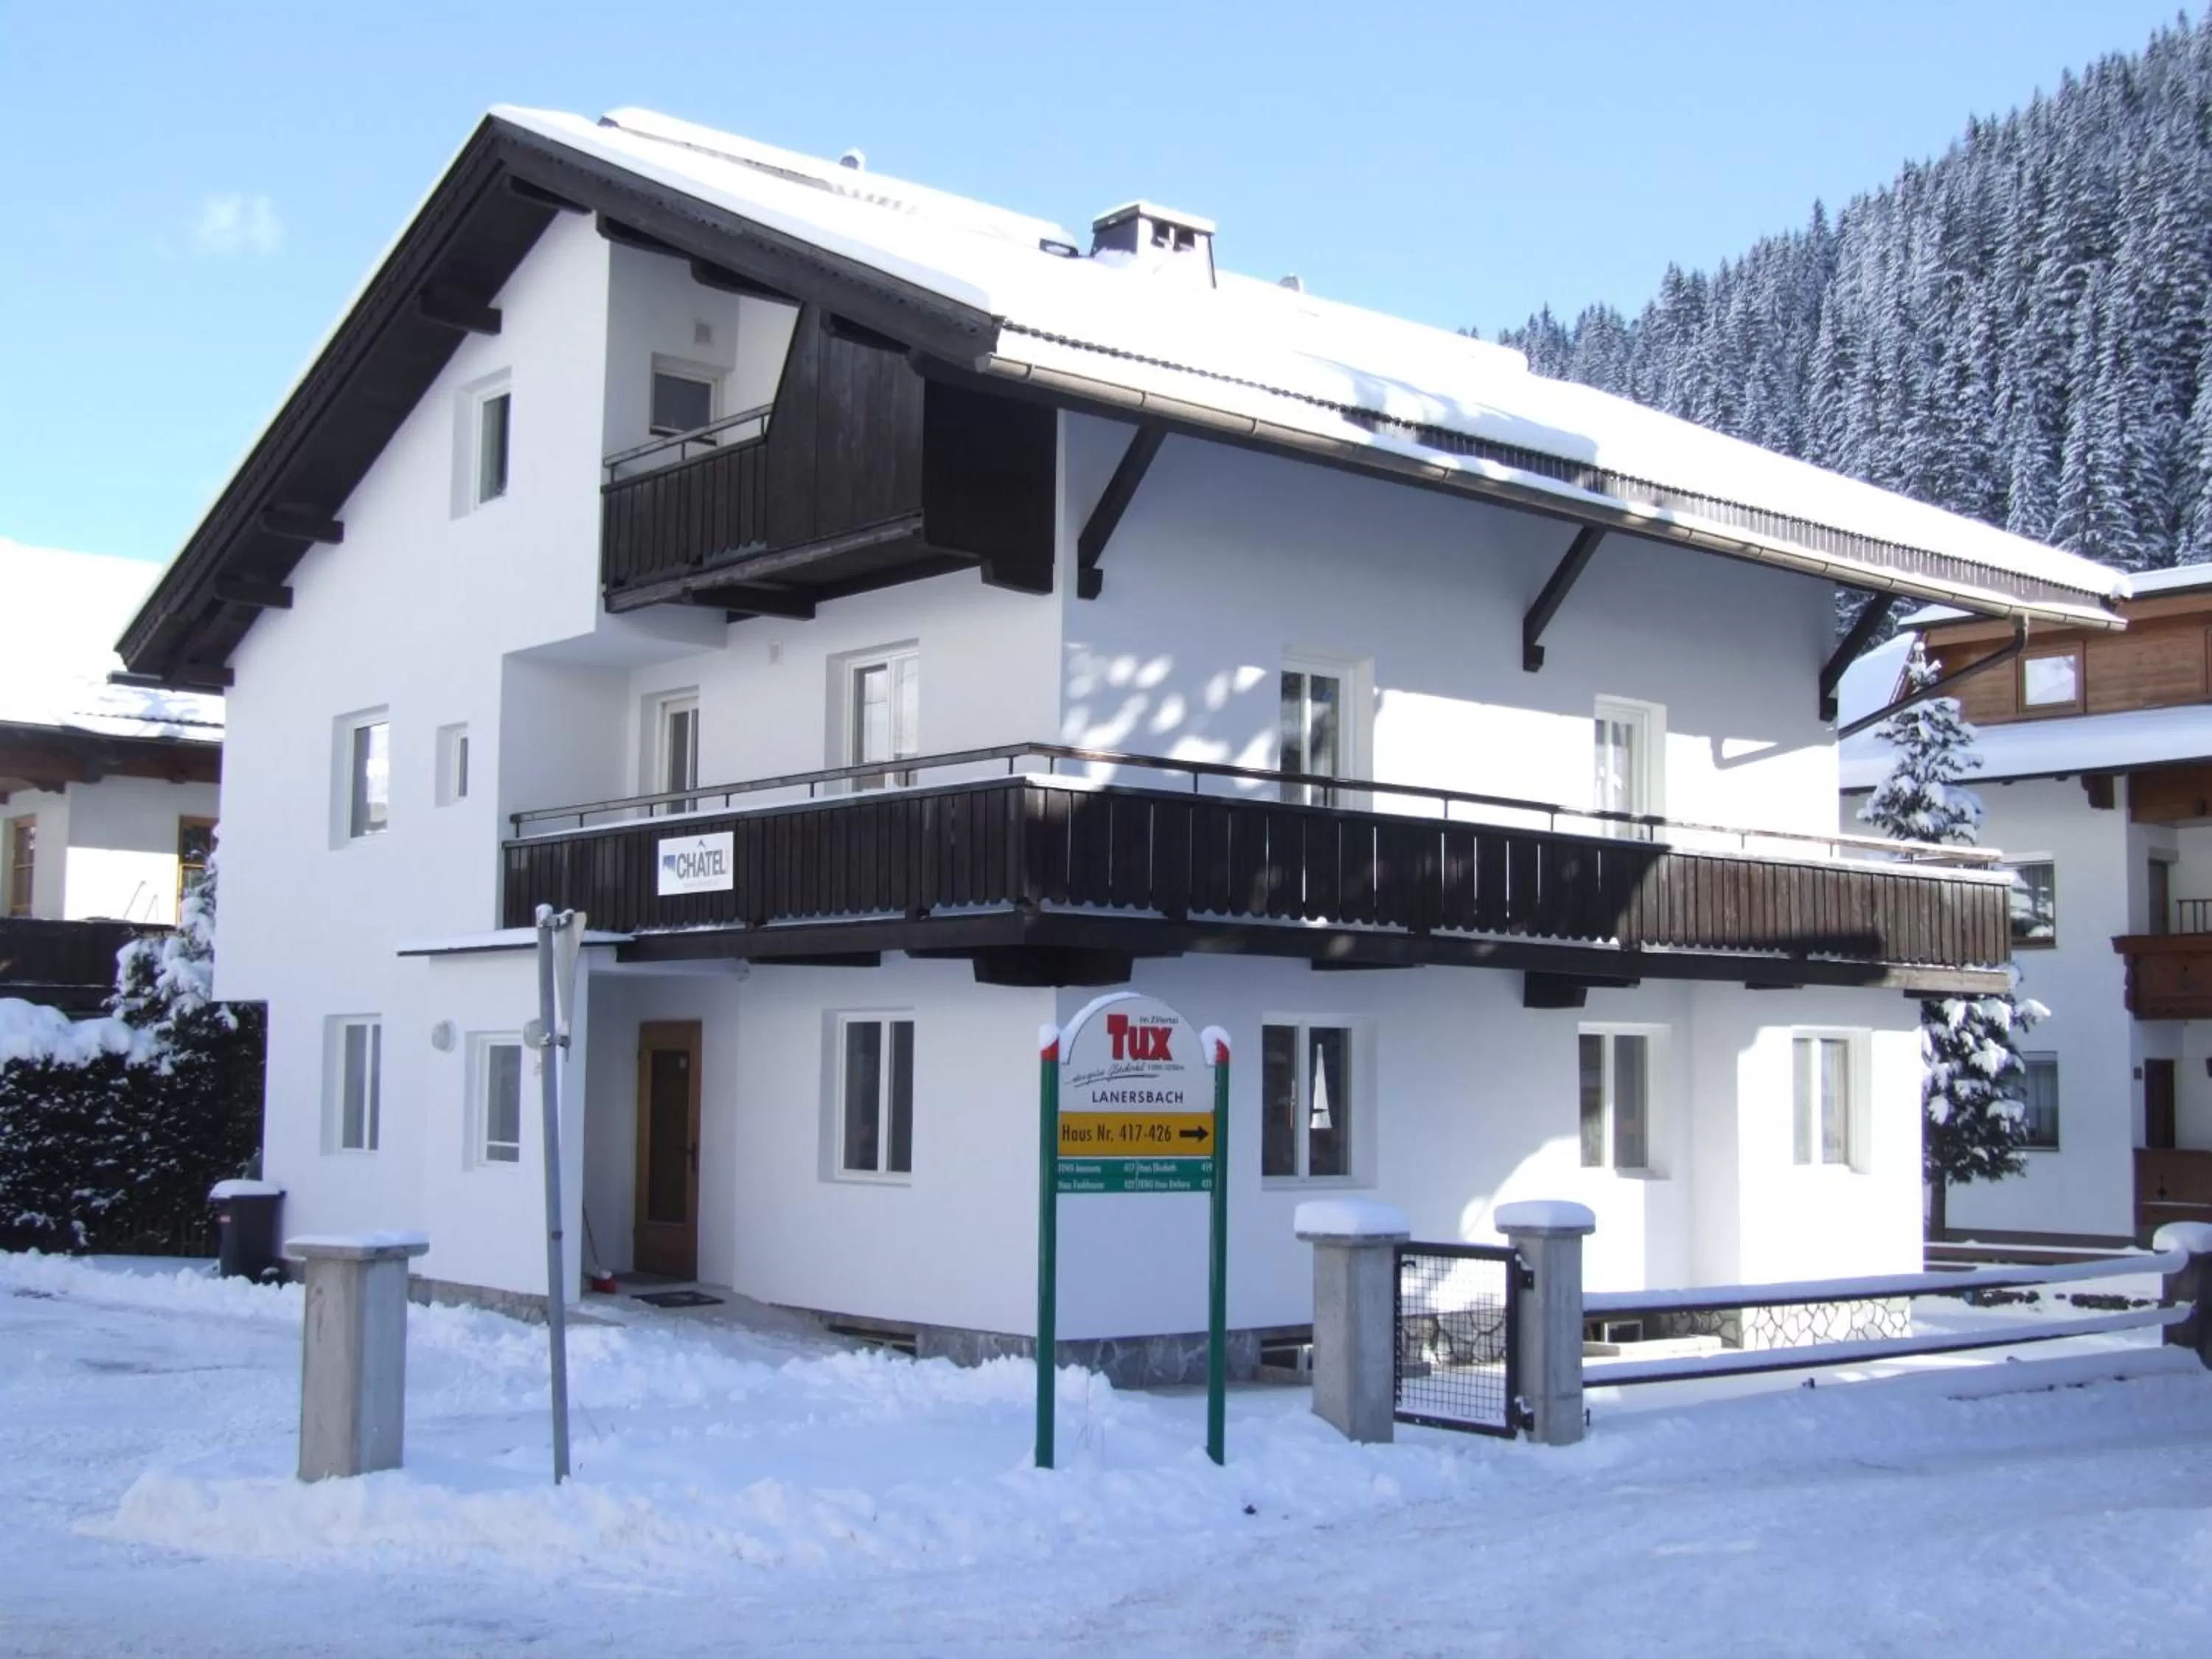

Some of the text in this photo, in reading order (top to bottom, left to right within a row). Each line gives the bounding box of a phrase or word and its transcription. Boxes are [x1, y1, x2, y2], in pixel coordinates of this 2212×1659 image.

[677, 838, 726, 879] CHÂTEL
[1091, 1091, 1184, 1105] LANERSBACH
[1062, 1123, 1172, 1142] Haus Nr. 417-426
